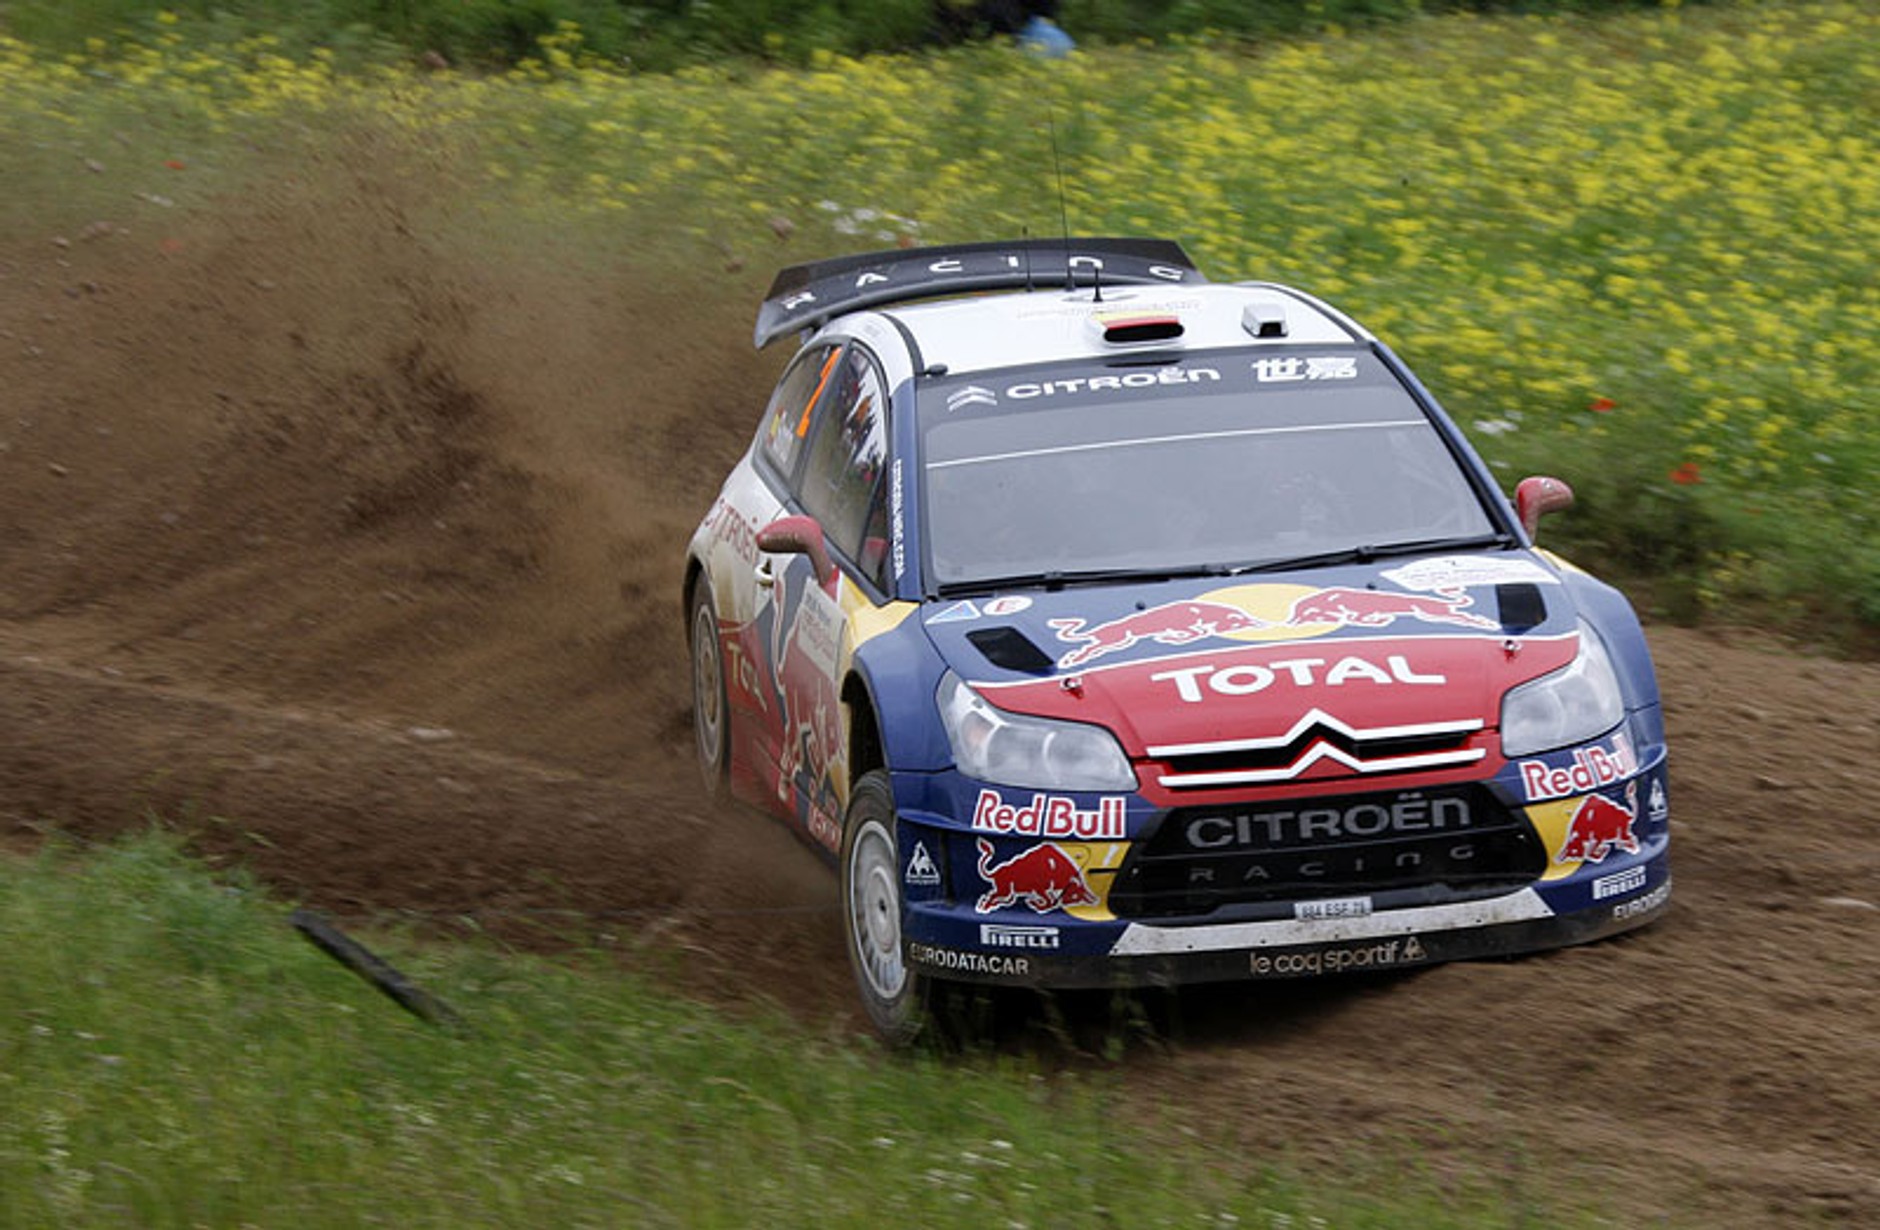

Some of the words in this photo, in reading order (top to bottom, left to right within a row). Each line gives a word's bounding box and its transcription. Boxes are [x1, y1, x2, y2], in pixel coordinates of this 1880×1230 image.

[1150, 655, 1446, 702] TOTAL
[1519, 748, 1595, 801] Red
[972, 789, 1046, 834] Red
[1044, 796, 1126, 838] Bull
[1592, 865, 1646, 900] PIRELLI
[980, 924, 1059, 948] PIRELLI
[910, 943, 1029, 975] EURODATACAR
[1250, 952, 1271, 973] le
[1274, 954, 1322, 975] coq
[1323, 940, 1399, 972] sportif
